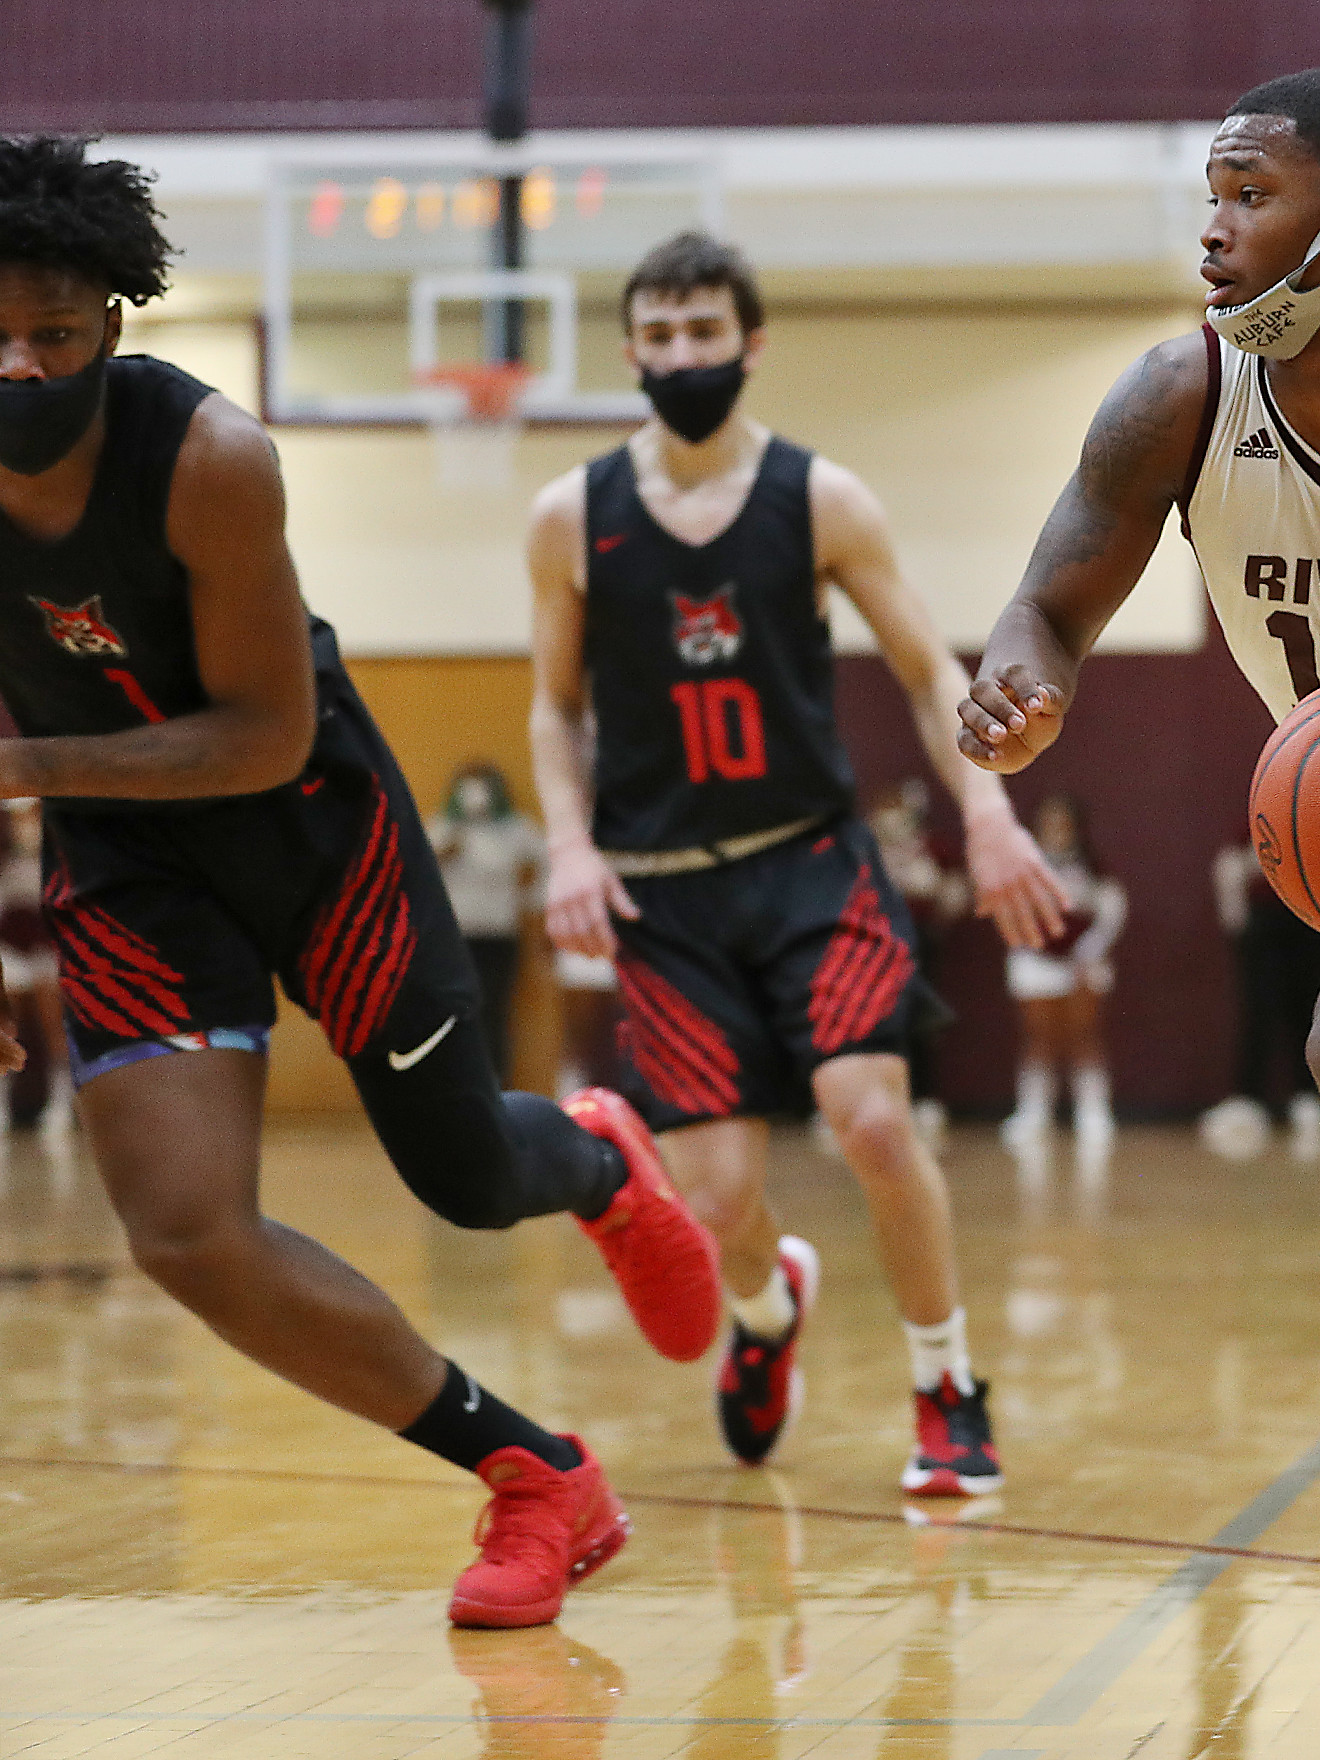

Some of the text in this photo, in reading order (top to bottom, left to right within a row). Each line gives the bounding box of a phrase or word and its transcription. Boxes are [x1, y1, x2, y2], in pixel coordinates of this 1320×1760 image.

[1233, 300, 1296, 345] AUBURN
[1256, 317, 1296, 347] CAFE
[1233, 446, 1279, 459] adidas
[103, 667, 168, 724] 1
[669, 676, 768, 784] 10
